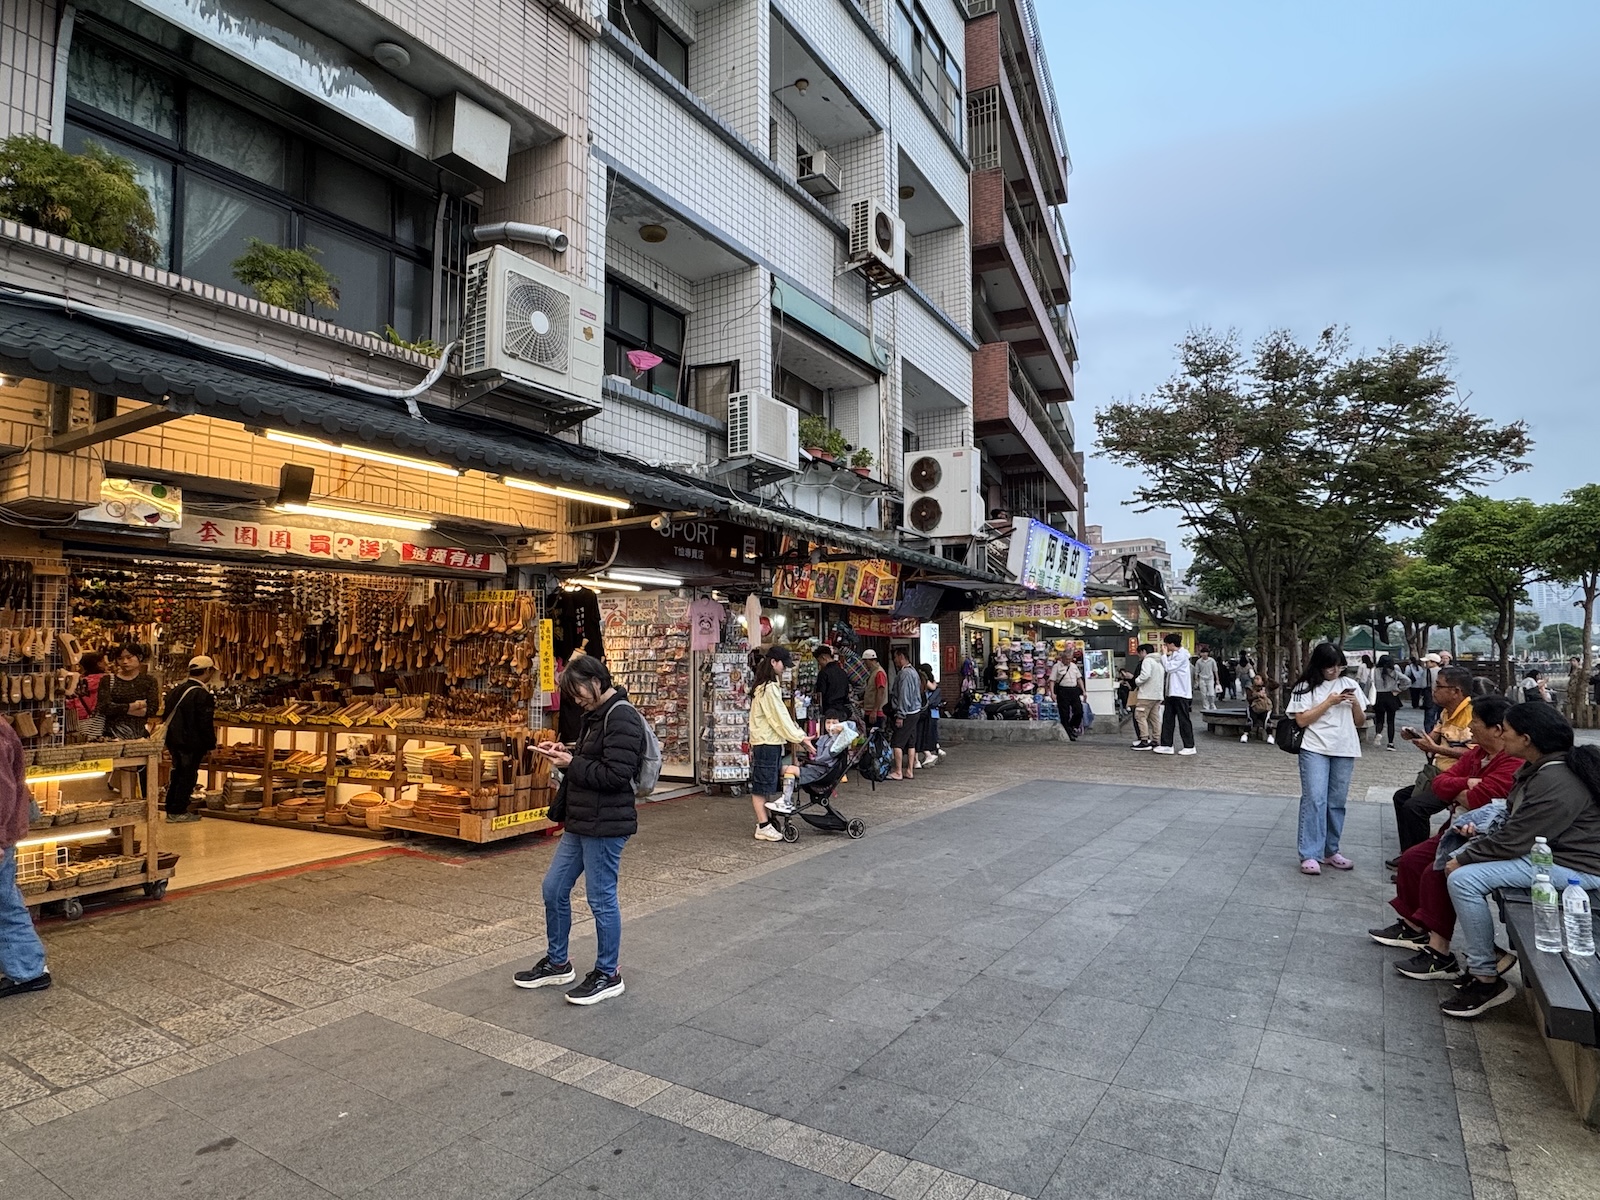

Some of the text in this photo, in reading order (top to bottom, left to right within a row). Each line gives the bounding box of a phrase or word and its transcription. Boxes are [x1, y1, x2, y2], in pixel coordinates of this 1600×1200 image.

[197, 521, 292, 550] 套圈圈
[1064, 607, 1090, 618] 便宜
